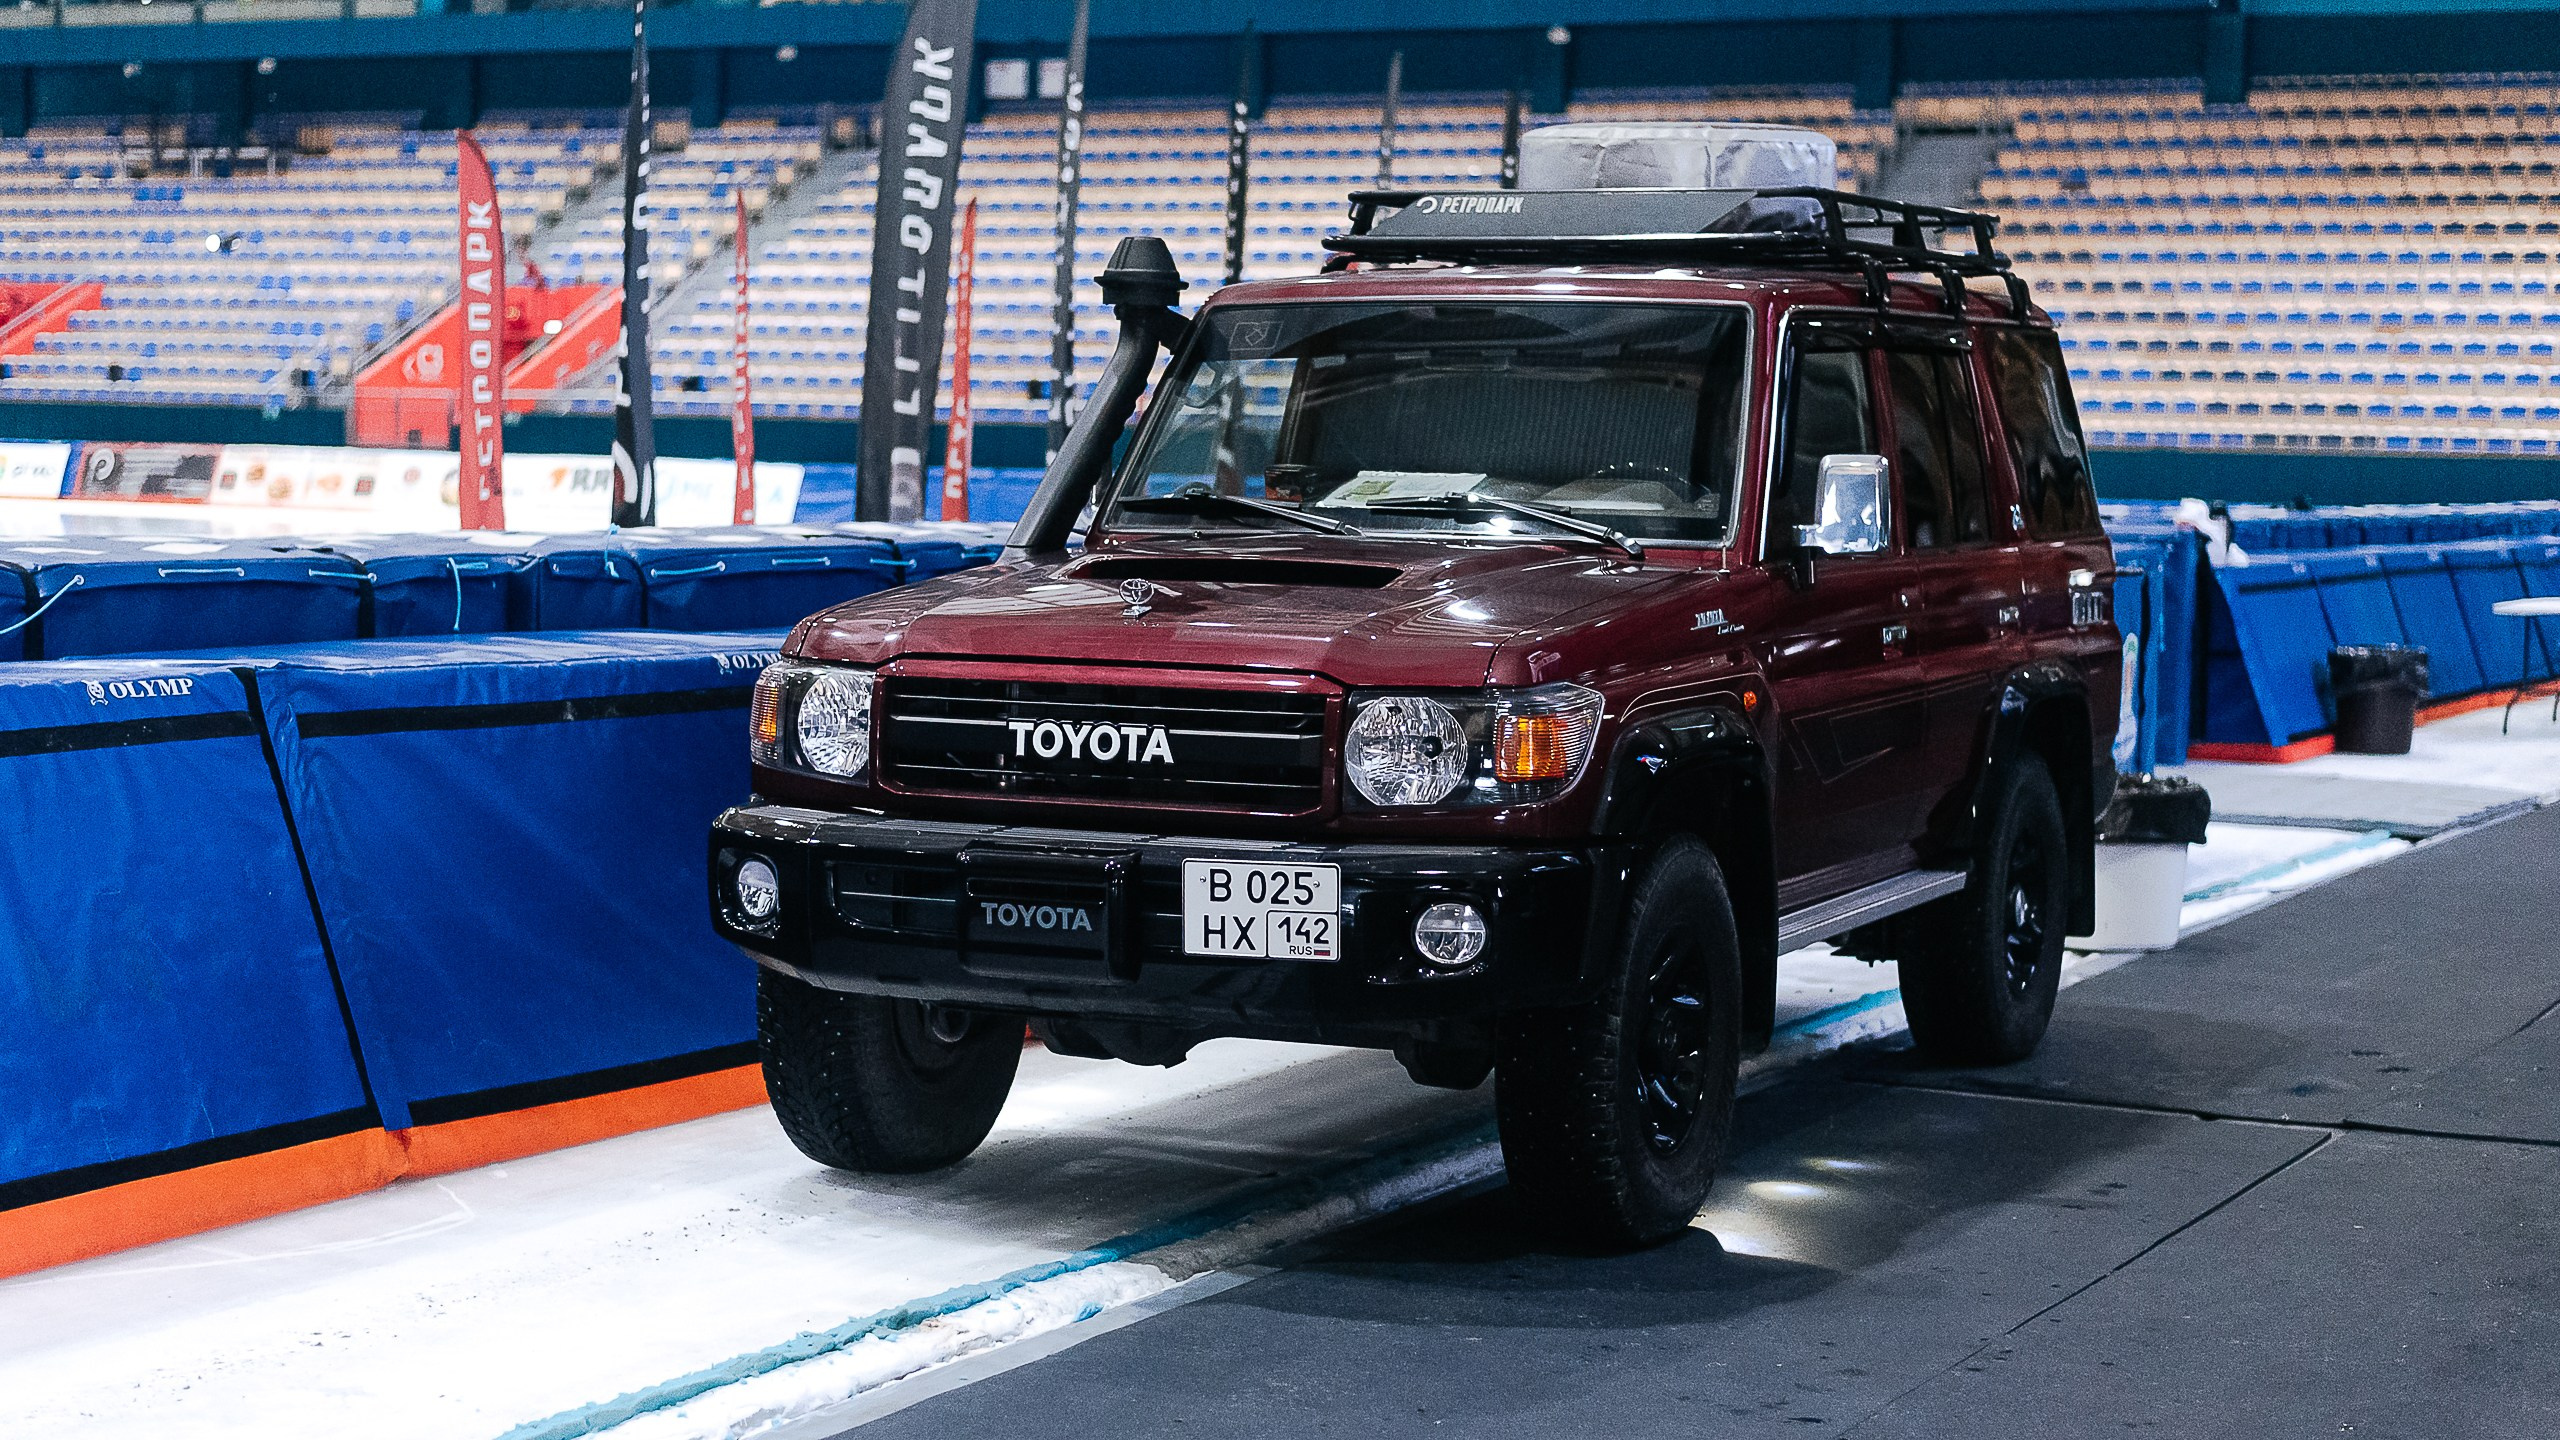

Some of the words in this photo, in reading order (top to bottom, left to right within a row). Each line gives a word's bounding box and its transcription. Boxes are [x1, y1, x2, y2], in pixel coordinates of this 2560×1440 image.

[1439, 196, 1525, 214] РЕТРОПАРК
[731, 652, 783, 669] OLYM
[108, 677, 193, 699] OLYMP
[1007, 720, 1175, 764] TOYOTA
[1246, 870, 1314, 906] 025
[980, 902, 1092, 932] TOYOTA
[1277, 916, 1330, 945] 142
[1289, 945, 1313, 956] RUS
